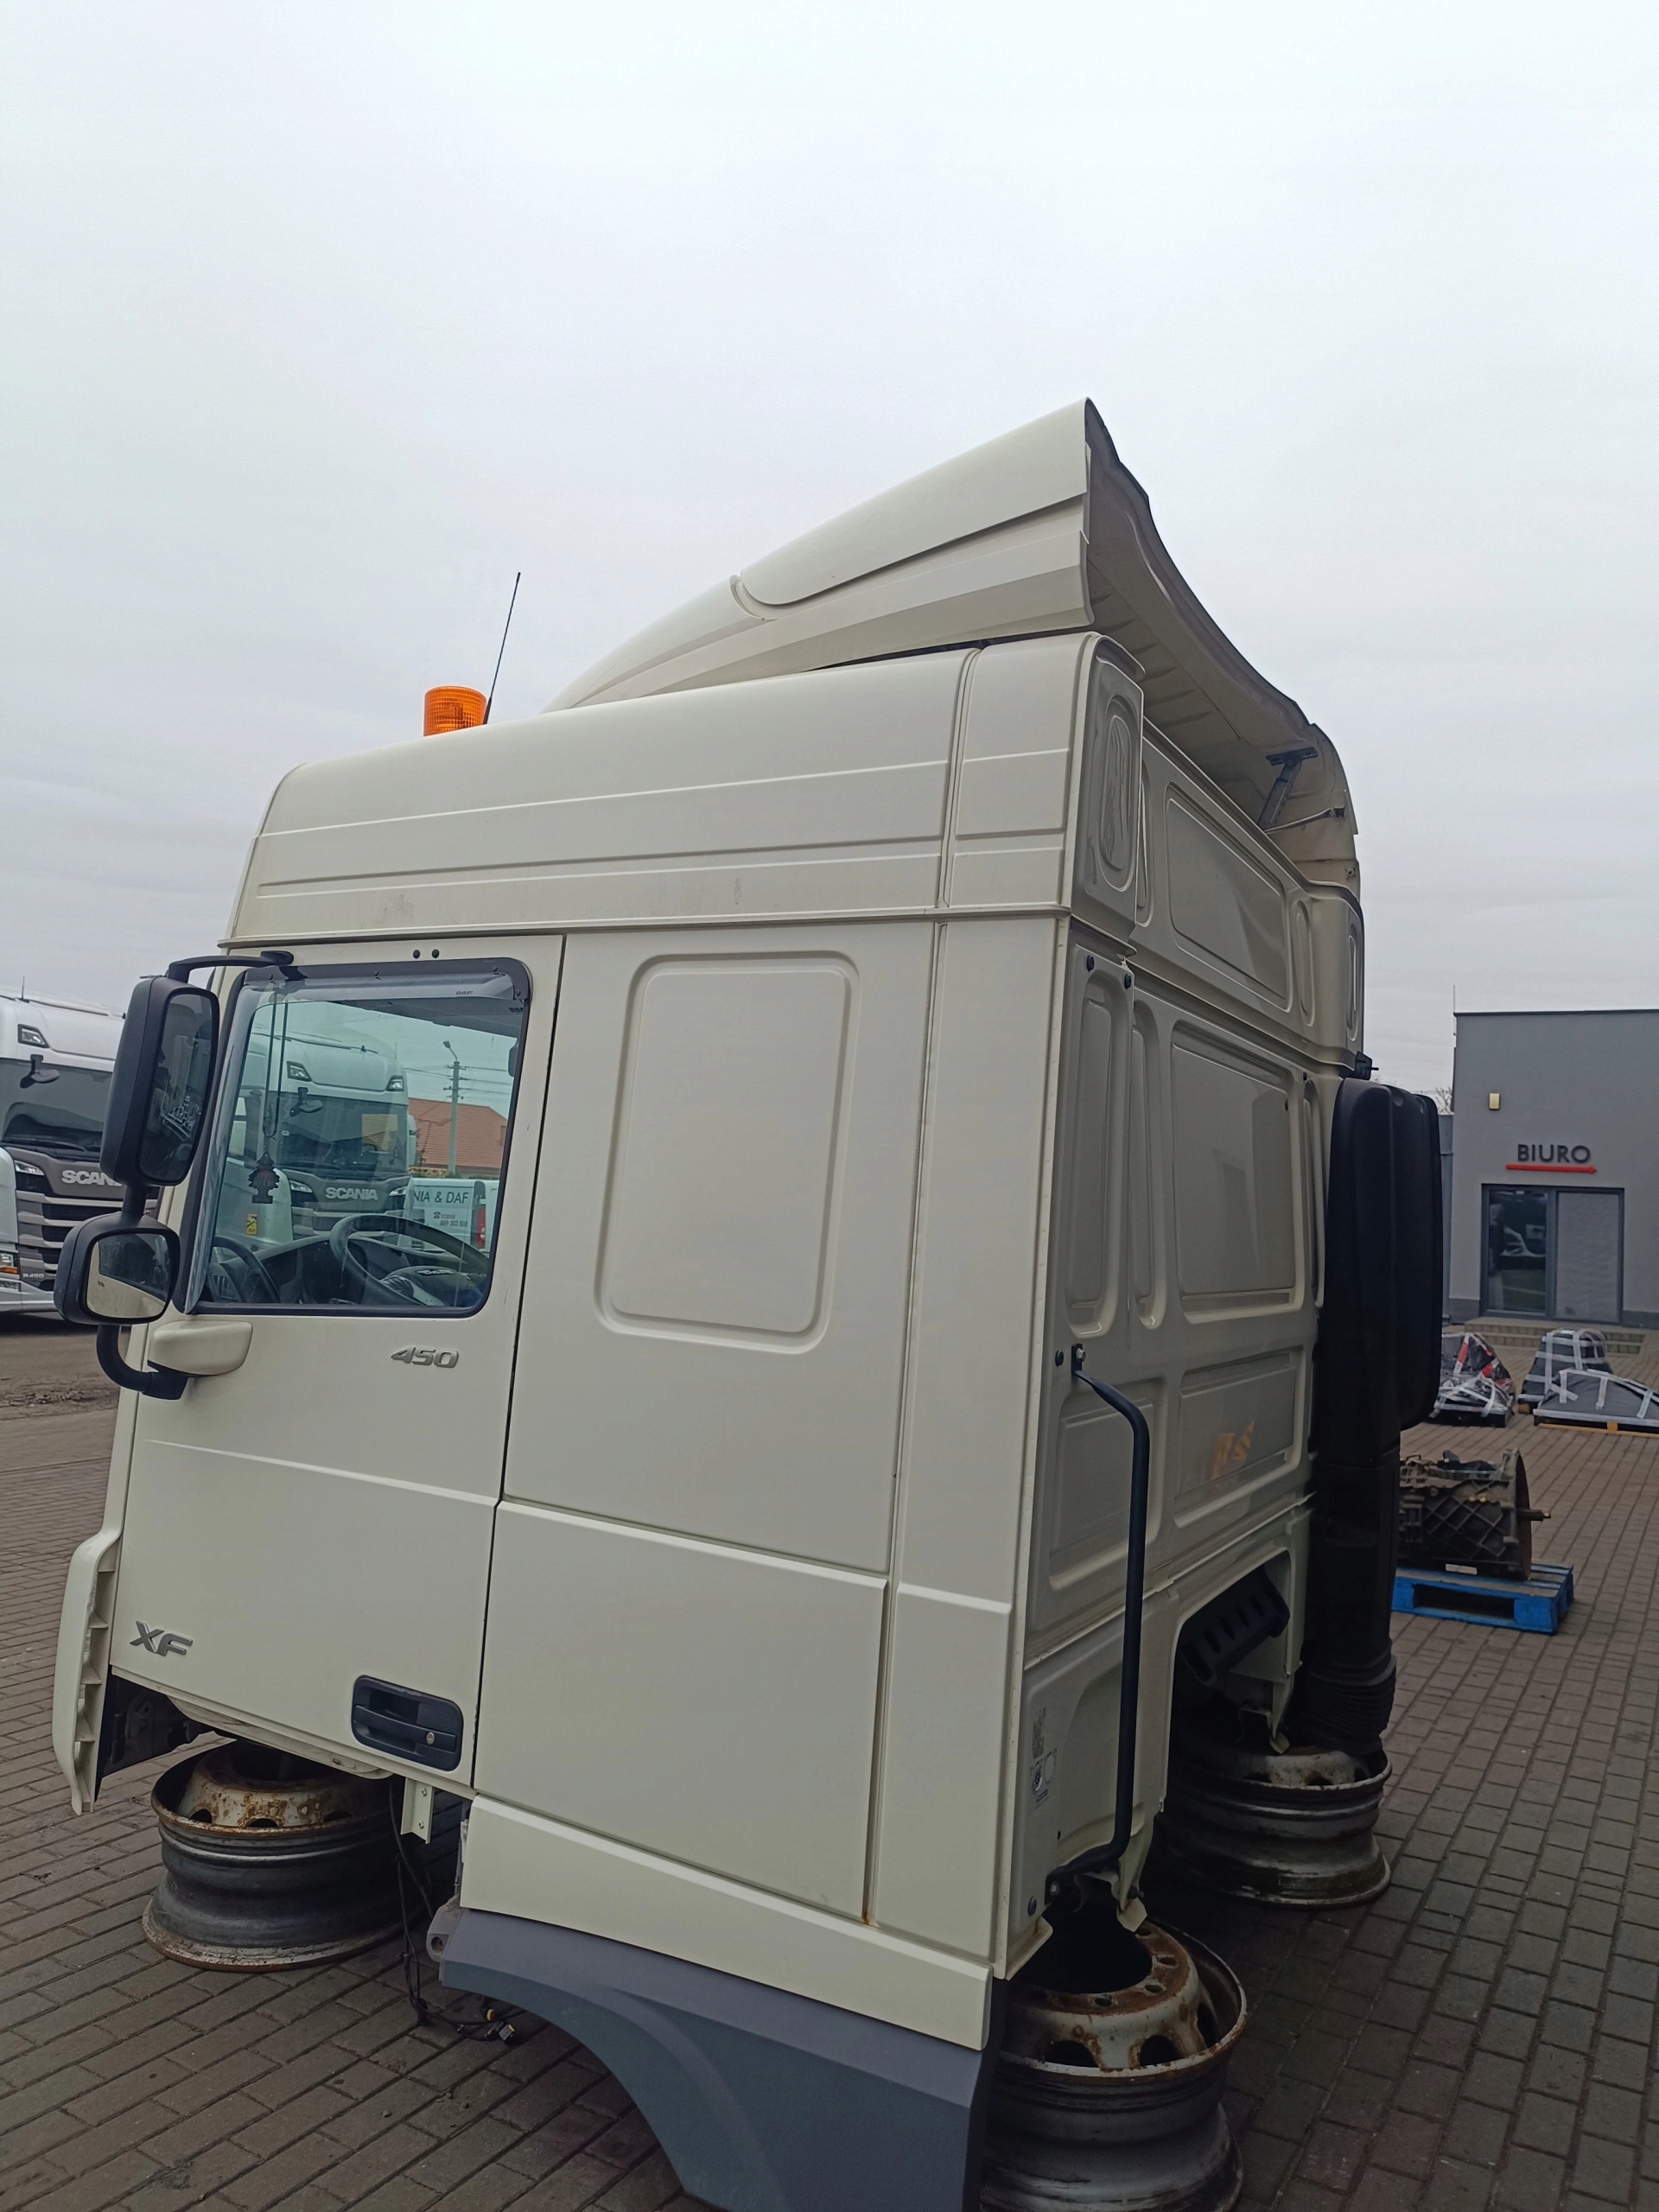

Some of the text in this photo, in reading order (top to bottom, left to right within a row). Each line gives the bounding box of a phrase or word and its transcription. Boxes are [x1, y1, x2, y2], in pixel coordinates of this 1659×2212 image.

[1517, 1144, 1591, 1164] BIURO
[61, 1169, 122, 1186] SCAN
[325, 1186, 378, 1200] SCANIA
[435, 1191, 442, 1203] &
[446, 1192, 468, 1204] DAF
[391, 1346, 460, 1369] 450
[129, 1620, 194, 1657] XF
